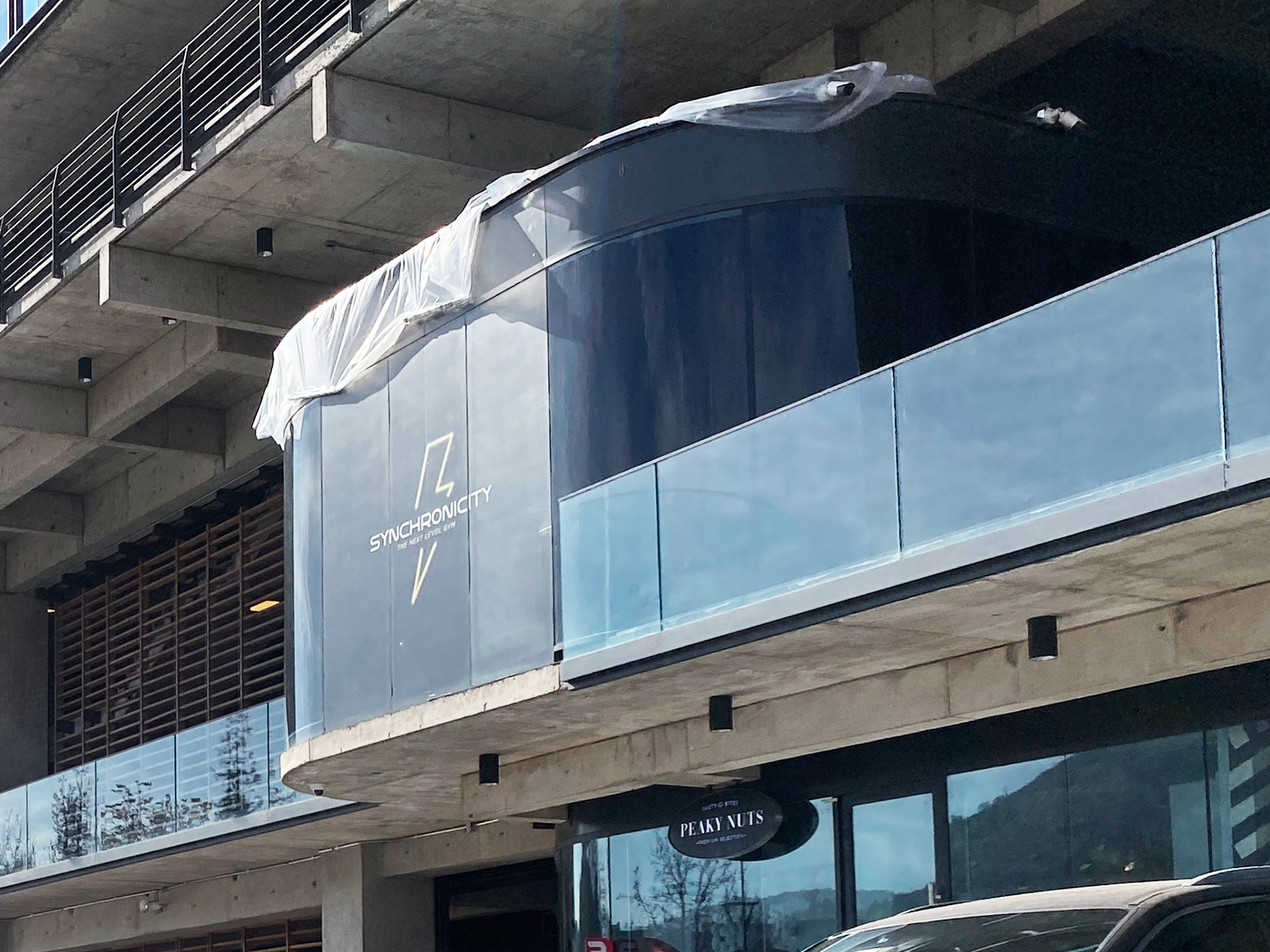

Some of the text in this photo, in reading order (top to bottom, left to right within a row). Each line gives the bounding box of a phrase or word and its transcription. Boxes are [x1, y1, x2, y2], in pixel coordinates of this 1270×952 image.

[370, 484, 492, 552] SYNCHRONICITY
[680, 809, 764, 838] PEAKY NUTS
